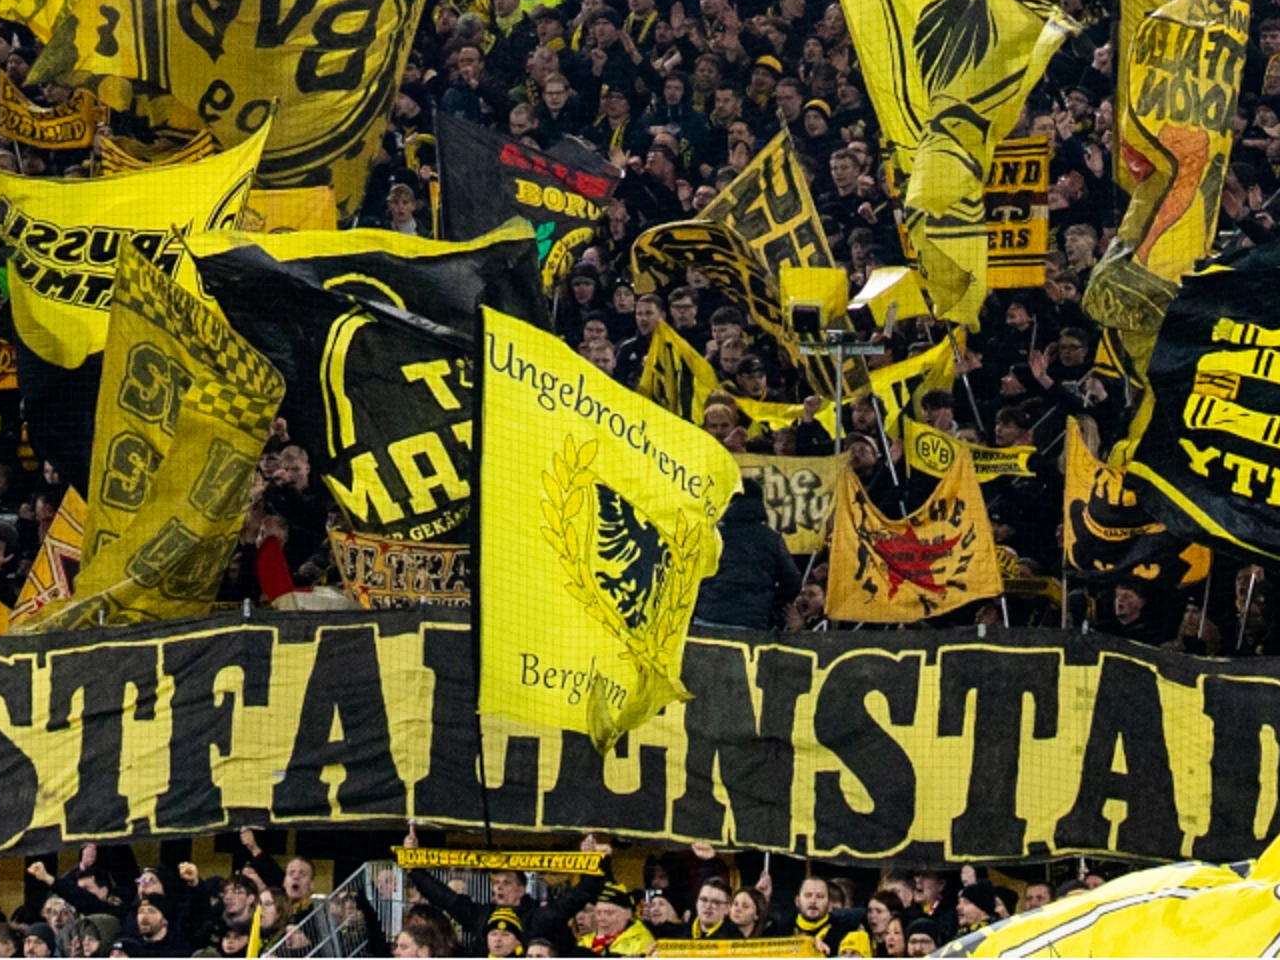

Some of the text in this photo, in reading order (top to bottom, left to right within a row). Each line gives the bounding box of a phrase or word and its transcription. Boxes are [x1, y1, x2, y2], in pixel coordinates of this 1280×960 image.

[515, 178, 607, 221] BORU
[920, 440, 950, 465] BVB
[397, 849, 601, 871] BORUSSIA DORTMUND
